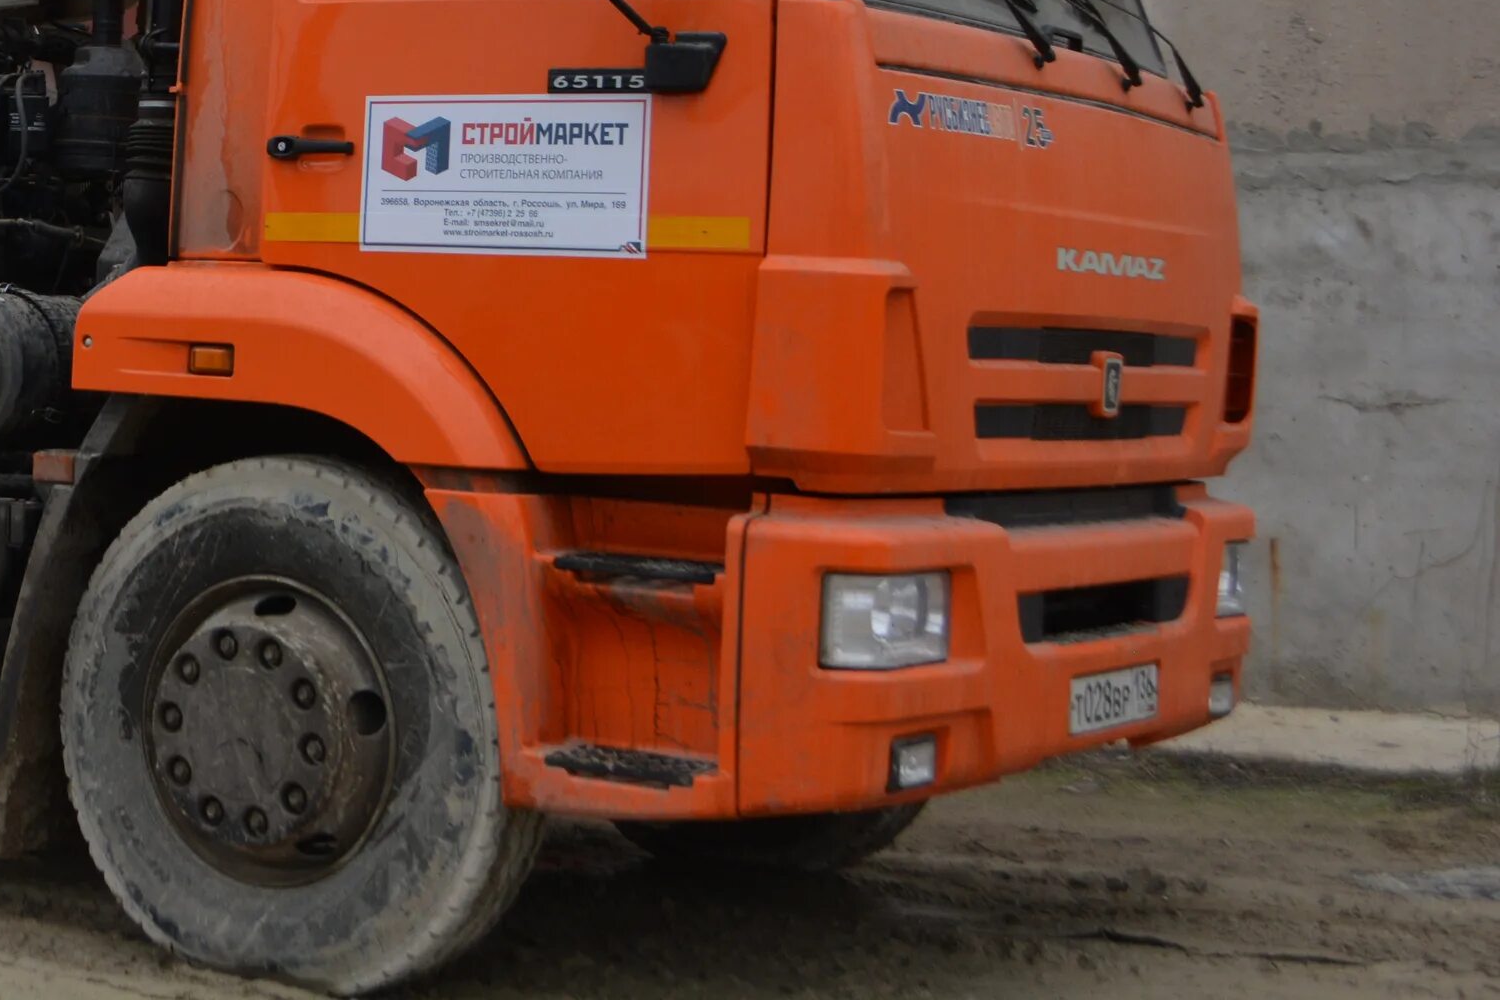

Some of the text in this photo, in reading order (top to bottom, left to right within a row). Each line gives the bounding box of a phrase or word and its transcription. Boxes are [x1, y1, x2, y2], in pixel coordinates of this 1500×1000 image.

[553, 74, 646, 89] 65115
[461, 117, 629, 146] СТРОЙМАРКЕТ
[460, 153, 568, 166] ПРОИЗВОДСТВЕННО-
[459, 169, 603, 181] СТРОИТЕЛЬНАЯ КОМПАНИЯ
[413, 198, 470, 208] Воронежская
[443, 218, 469, 226] E-mail:
[1056, 247, 1166, 280] KAMAZ
